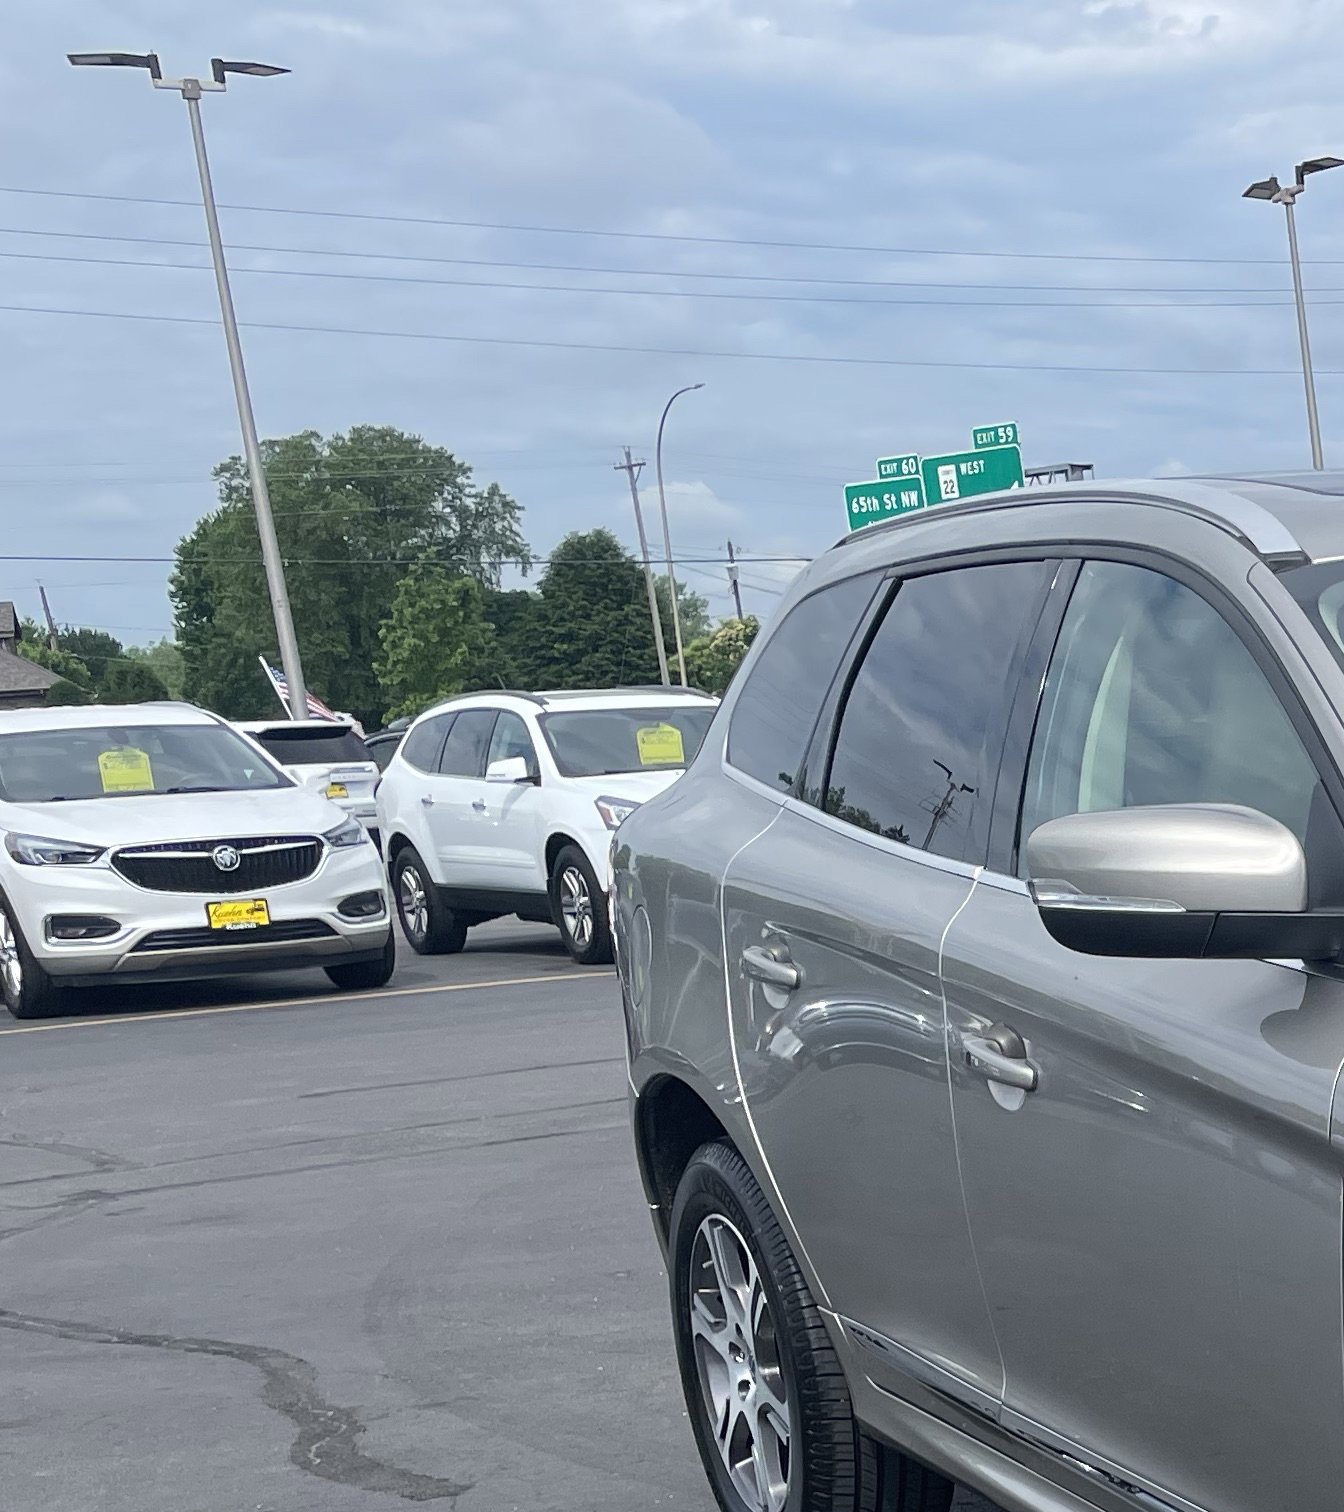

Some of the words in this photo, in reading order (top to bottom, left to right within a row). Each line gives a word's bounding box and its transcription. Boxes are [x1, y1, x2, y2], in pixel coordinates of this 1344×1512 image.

[976, 431, 995, 445] EXIT
[997, 426, 1014, 443] 59
[881, 462, 898, 476] EXIT
[901, 458, 917, 475] 60
[959, 460, 986, 476] WEST
[943, 479, 956, 496] 22
[851, 492, 880, 514] 65th
[883, 491, 898, 511] St
[900, 490, 919, 508] NW
